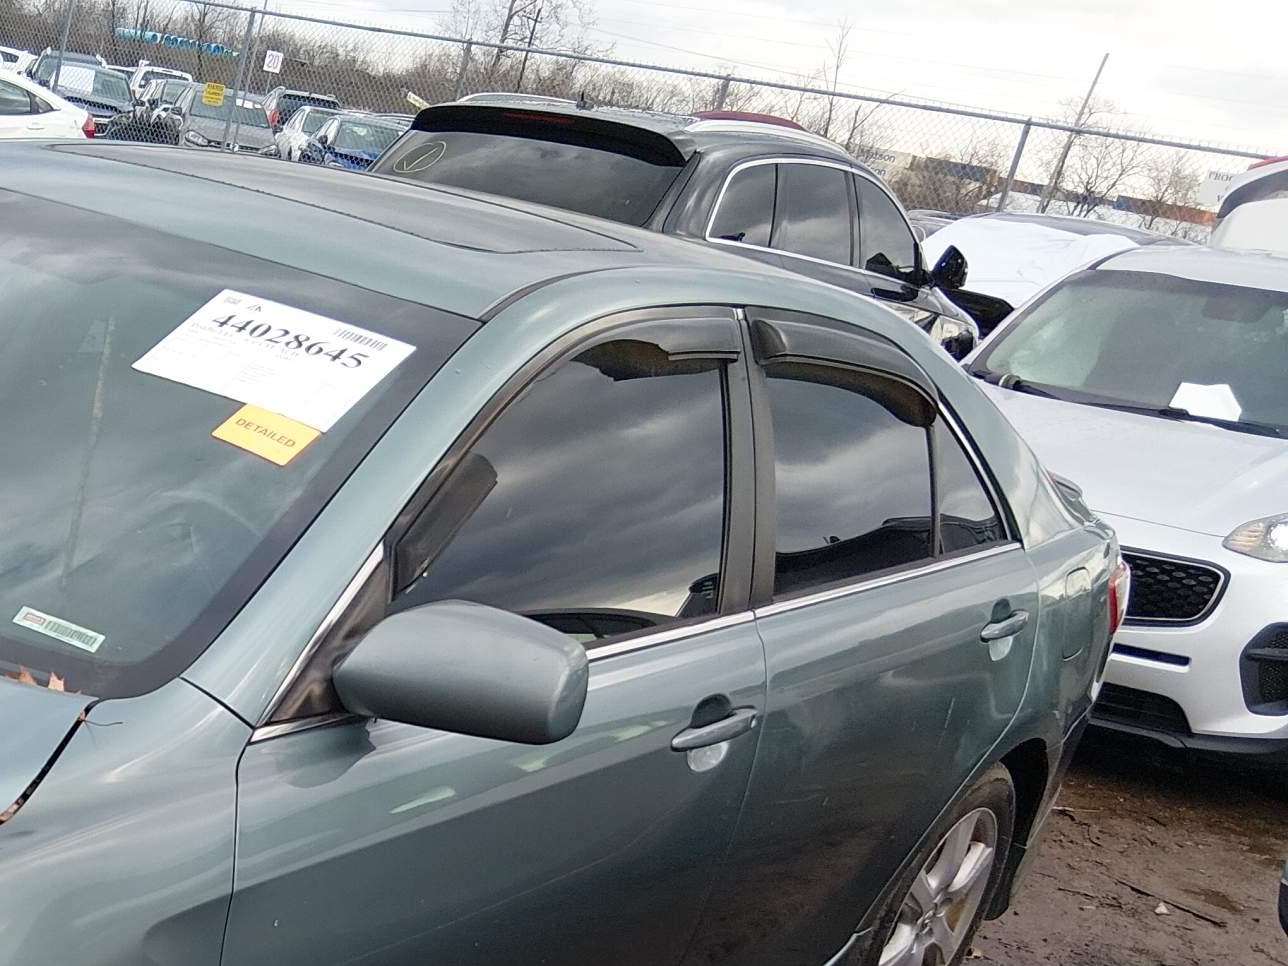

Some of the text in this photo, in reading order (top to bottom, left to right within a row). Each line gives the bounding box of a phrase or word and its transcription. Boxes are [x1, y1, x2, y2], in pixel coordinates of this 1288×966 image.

[267, 54, 280, 70] 20
[212, 313, 370, 369] 44028645
[235, 417, 296, 448] DETAILED
